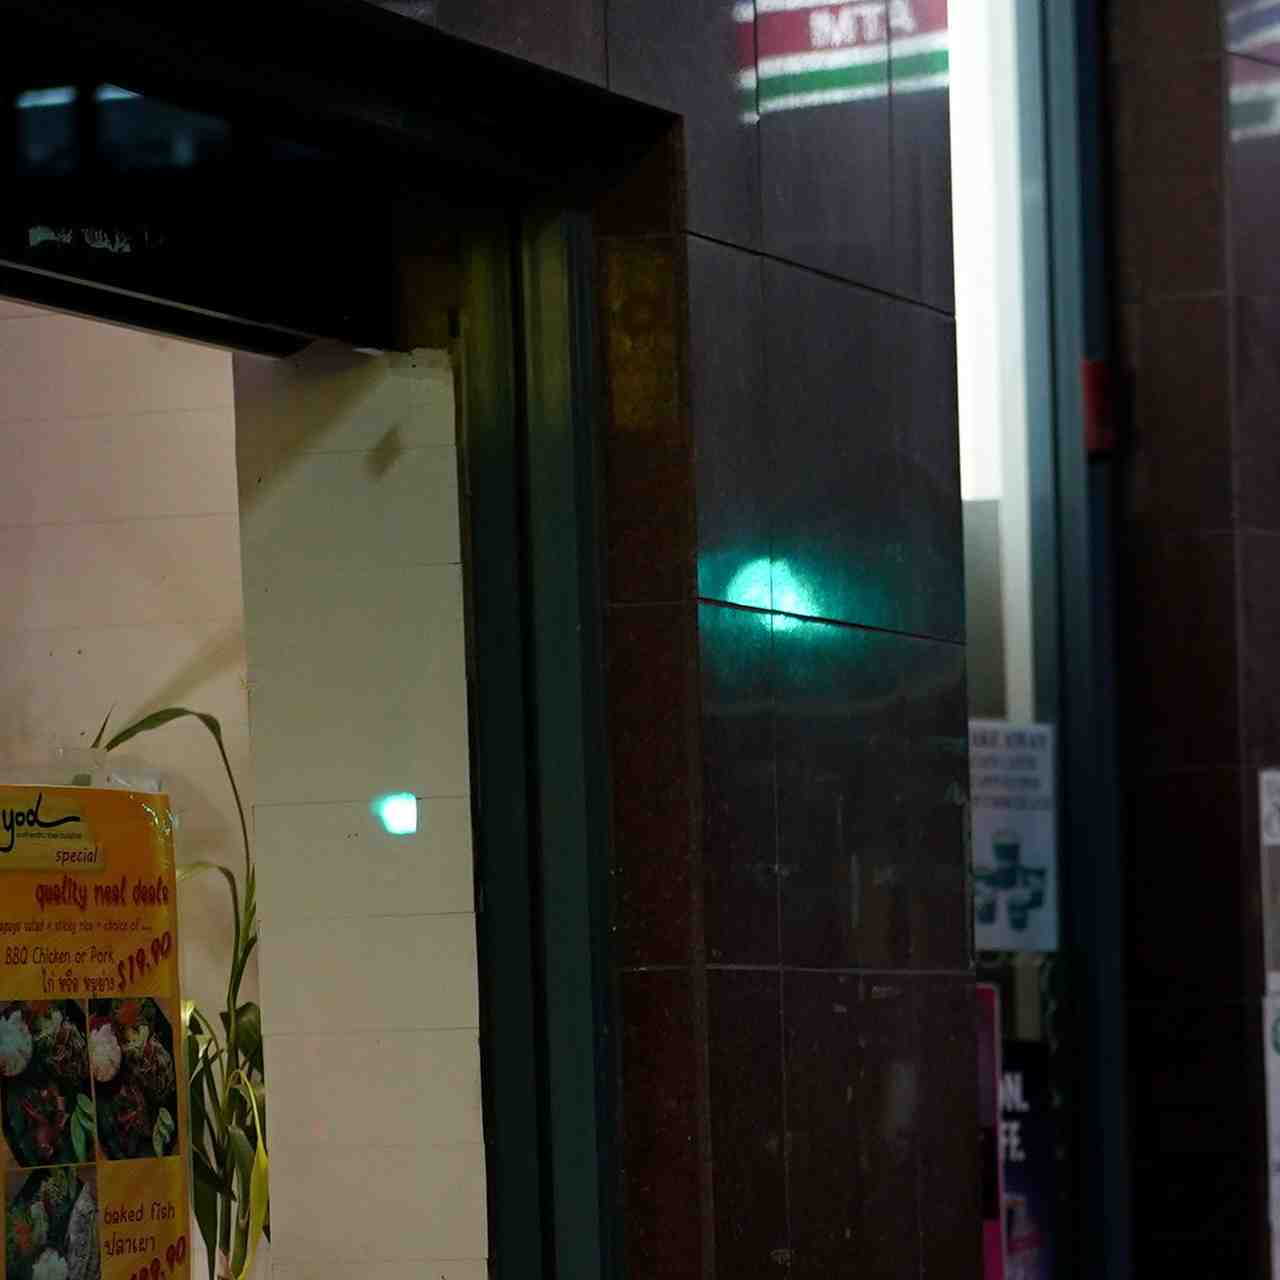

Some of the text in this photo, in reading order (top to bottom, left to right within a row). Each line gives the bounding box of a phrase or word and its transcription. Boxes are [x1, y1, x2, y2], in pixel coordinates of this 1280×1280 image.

[55, 847, 98, 866] special
[35, 874, 88, 912] quality
[4, 945, 28, 965] BBQ
[32, 945, 71, 965] Chicken
[104, 1200, 176, 1225] baked fish
